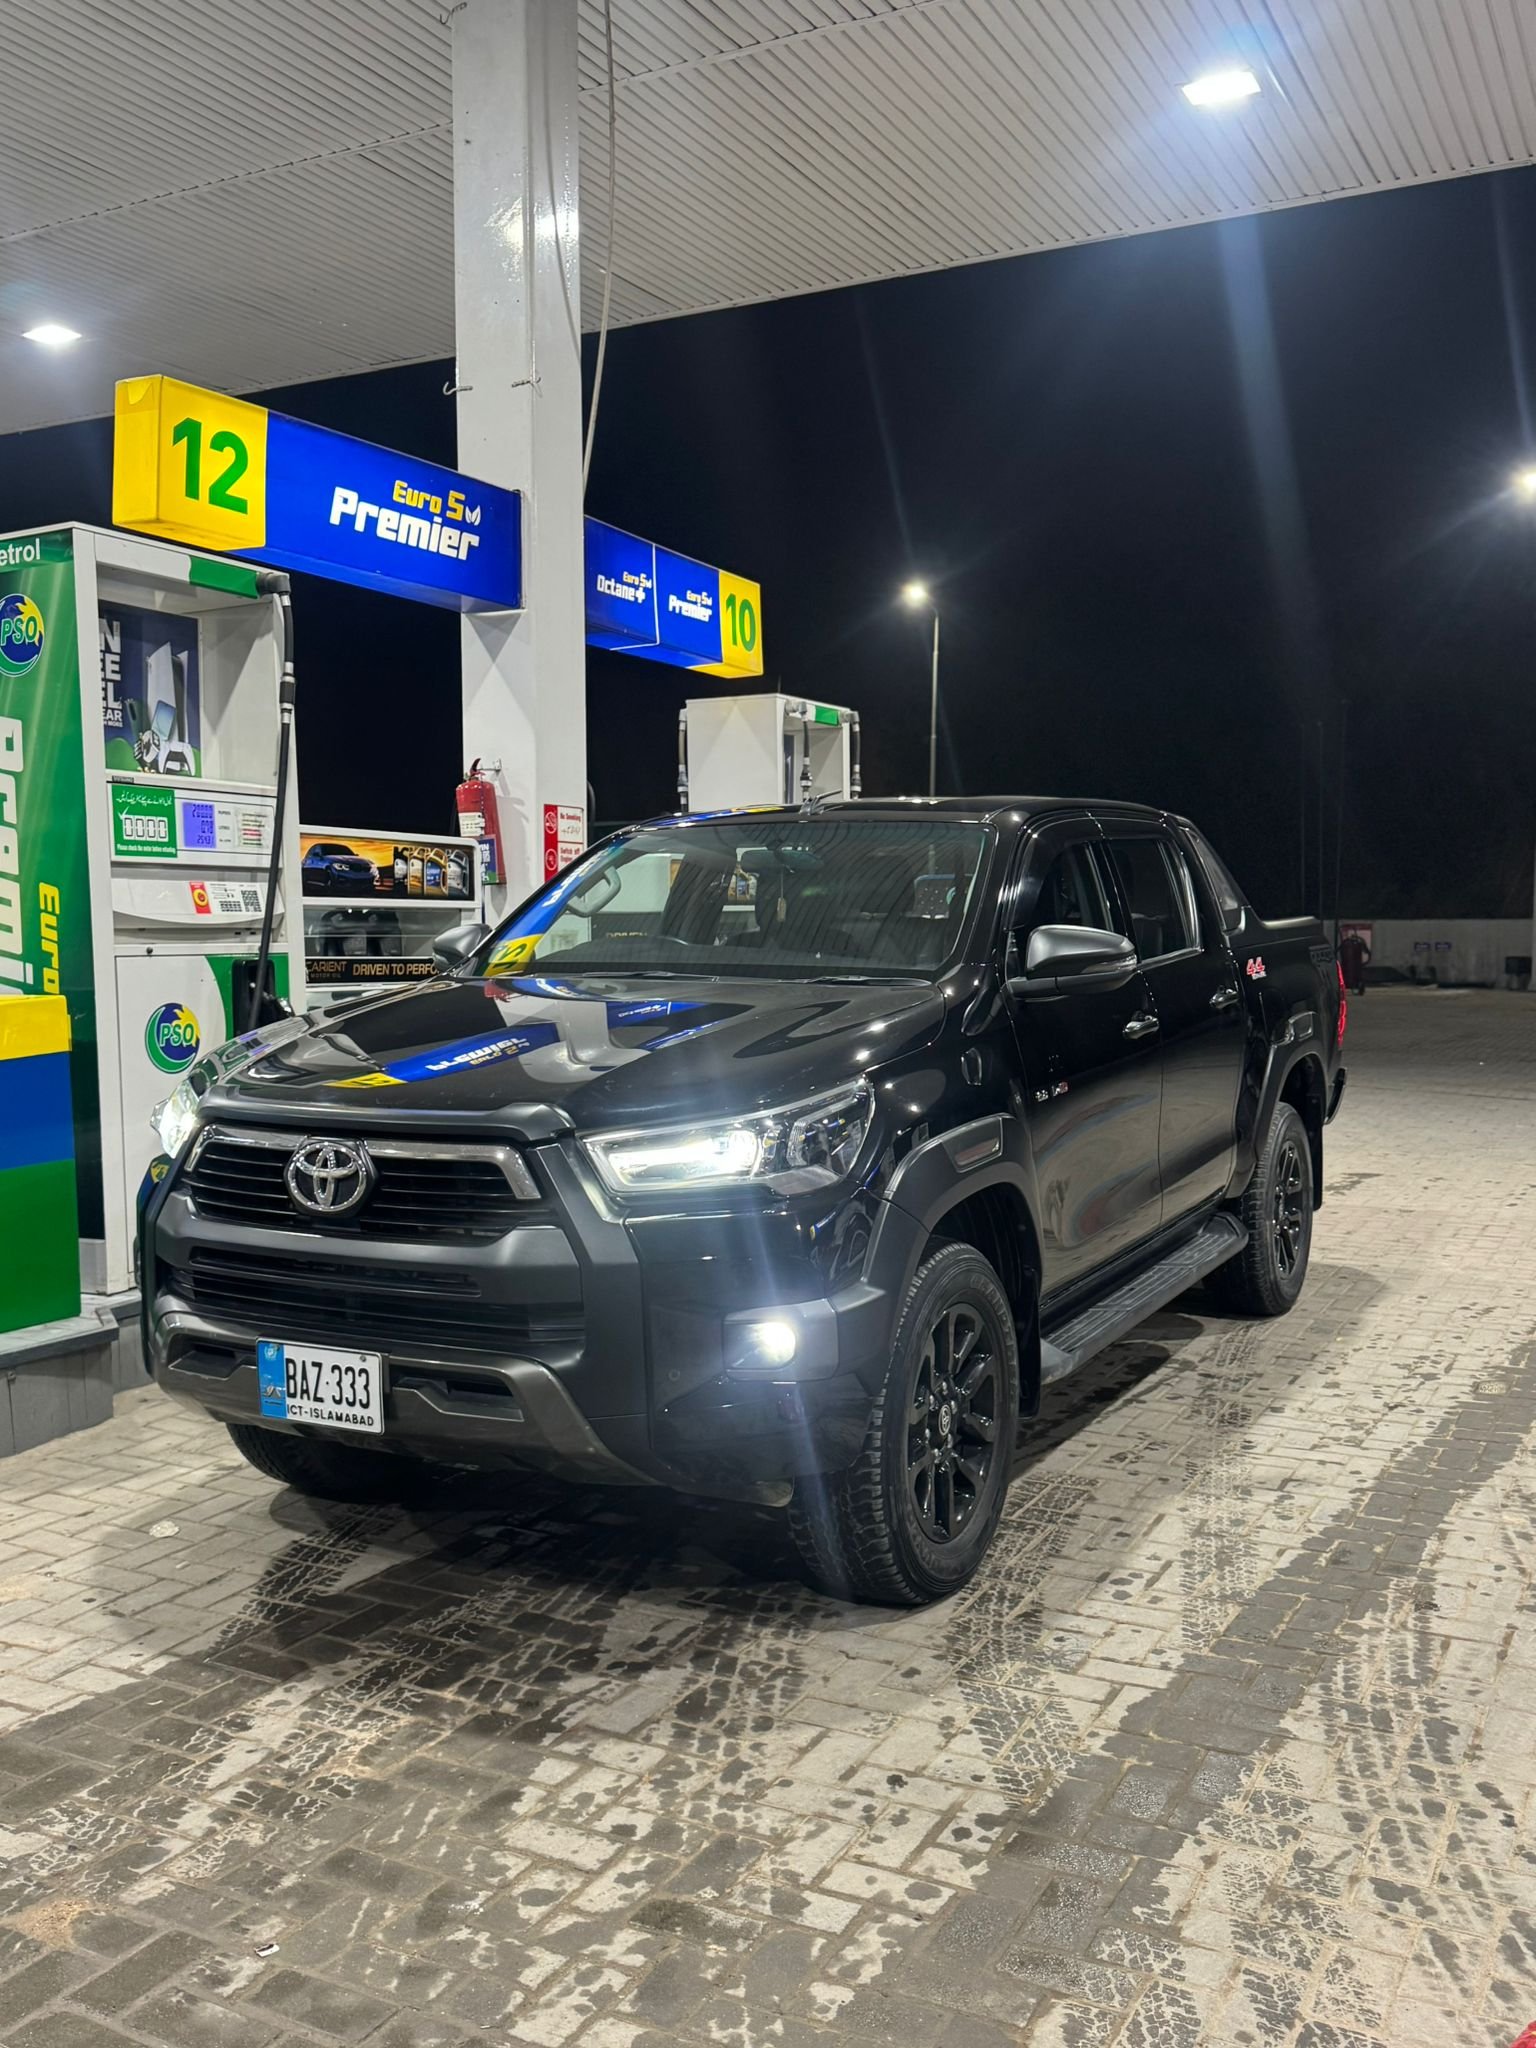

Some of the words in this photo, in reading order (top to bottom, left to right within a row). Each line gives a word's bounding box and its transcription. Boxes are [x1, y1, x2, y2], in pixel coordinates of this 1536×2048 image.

[172, 417, 249, 515] 12
[393, 480, 442, 514] Euro
[446, 491, 466, 521] 5
[329, 487, 480, 560] Premier
[623, 571, 639, 584] Euro
[668, 594, 713, 622] Premier
[686, 590, 701, 601] Euro
[1, 616, 39, 646] PSO
[726, 593, 756, 653] 10
[39, 882, 60, 995] Euro
[352, 963, 390, 976] DRIVEN
[391, 963, 405, 975] TO
[406, 963, 440, 975] PERFO
[160, 1023, 195, 1047] PSO
[287, 1404, 374, 1426] ICT-ISLAMABAD
